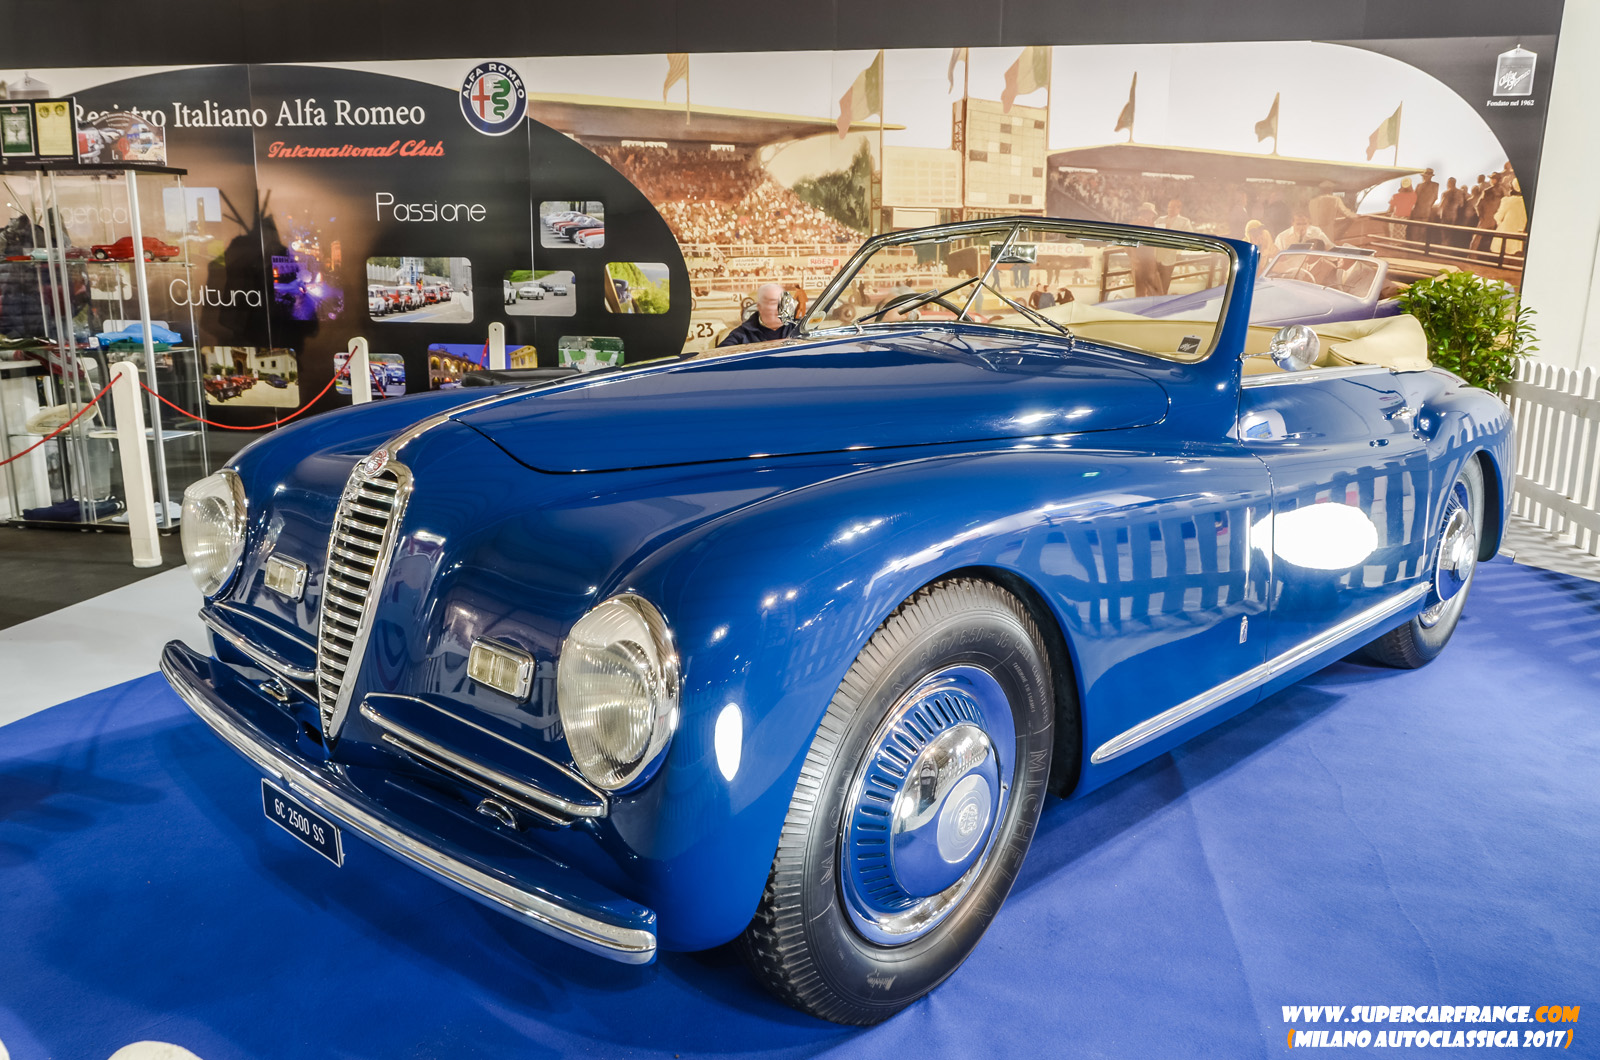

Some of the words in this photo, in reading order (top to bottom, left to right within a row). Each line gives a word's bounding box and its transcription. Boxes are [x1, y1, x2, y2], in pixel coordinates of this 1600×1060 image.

[463, 67, 484, 99] ALFA
[488, 63, 525, 99] ROMEO
[172, 99, 268, 128] Italiano
[275, 97, 328, 126] Alfa
[334, 99, 426, 126] Romeo
[267, 140, 400, 158] International
[399, 139, 446, 157] Club
[375, 191, 487, 222] Passione
[169, 278, 262, 307] Cultura
[696, 322, 715, 339] 23
[274, 798, 286, 819] 6C
[287, 807, 310, 836] 2500
[312, 823, 325, 845] SS
[972, 748, 1049, 926] MICHELIN
